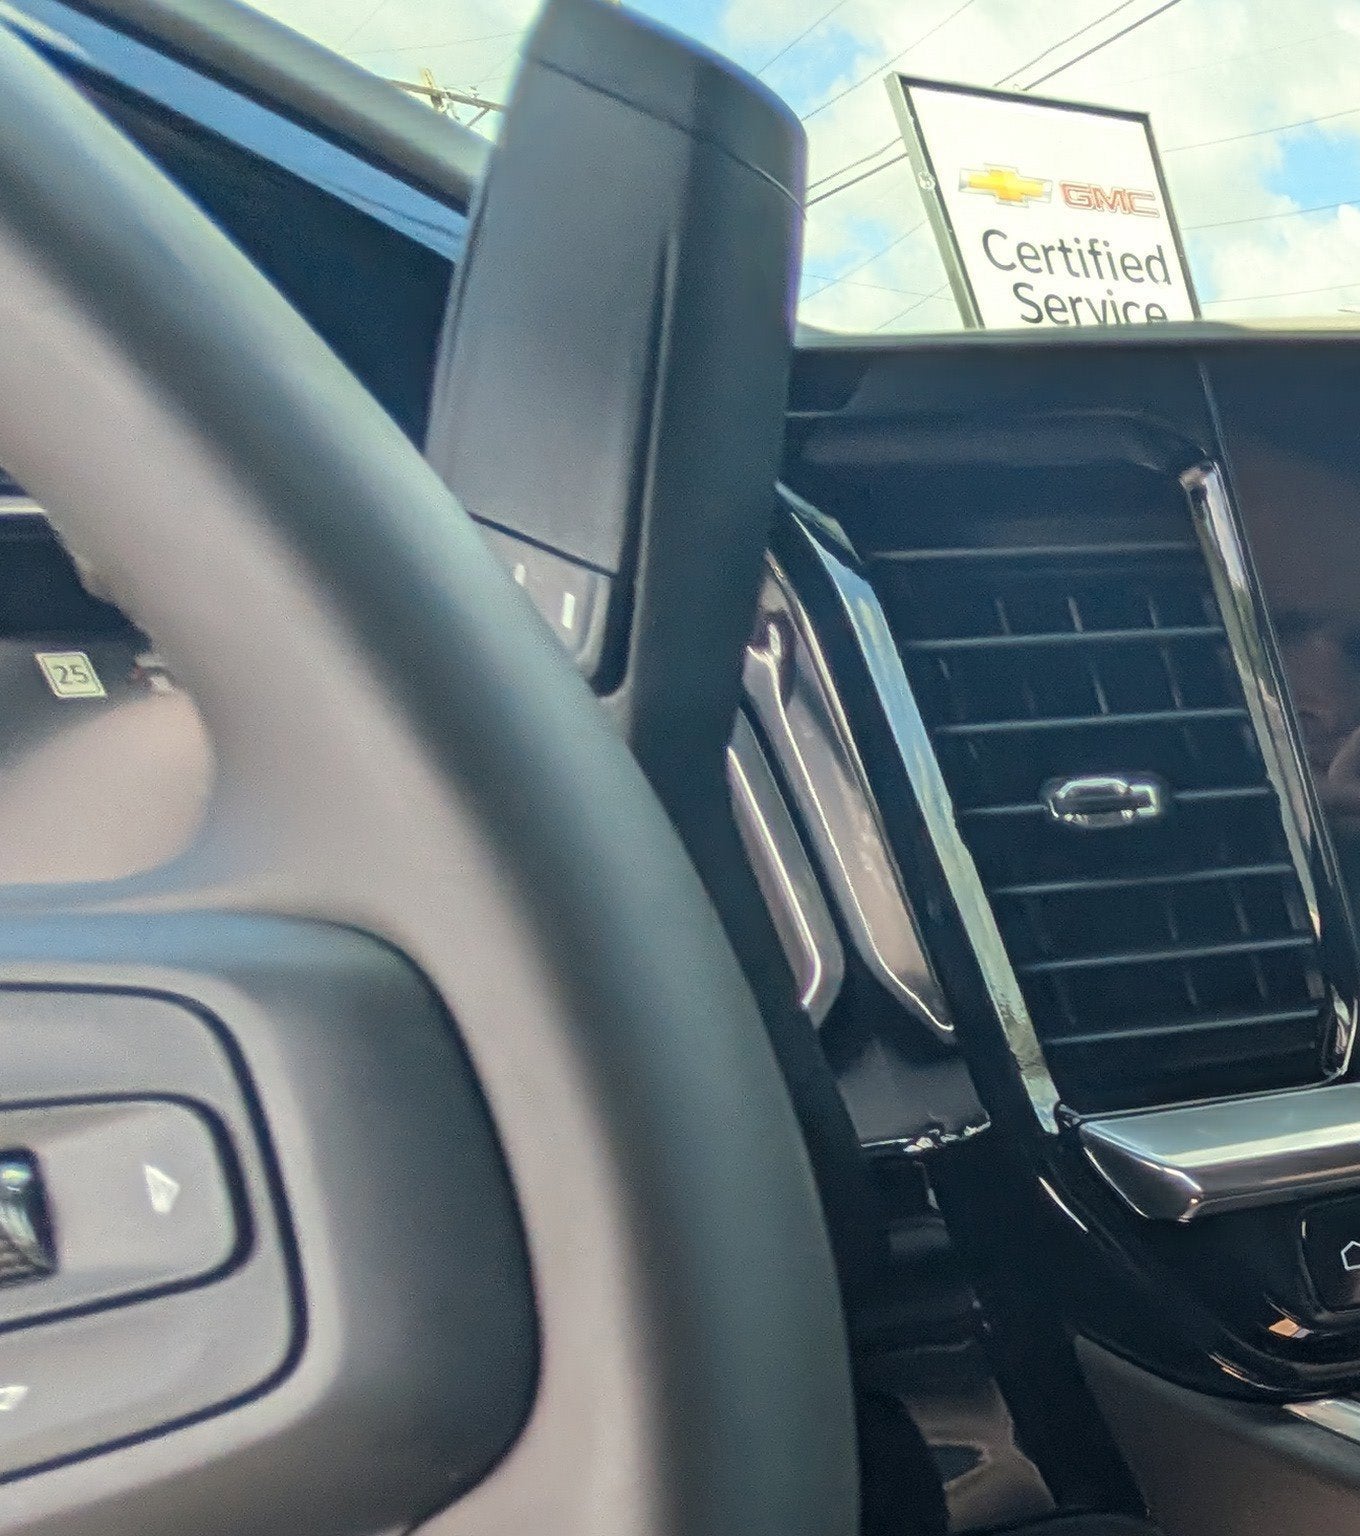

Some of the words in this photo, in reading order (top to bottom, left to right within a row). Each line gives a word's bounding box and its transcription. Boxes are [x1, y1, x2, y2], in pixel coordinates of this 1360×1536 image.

[1060, 181, 1160, 218] GMC
[982, 228, 1171, 285] Certified
[1013, 282, 1168, 325] Service
[53, 664, 89, 685] 25
